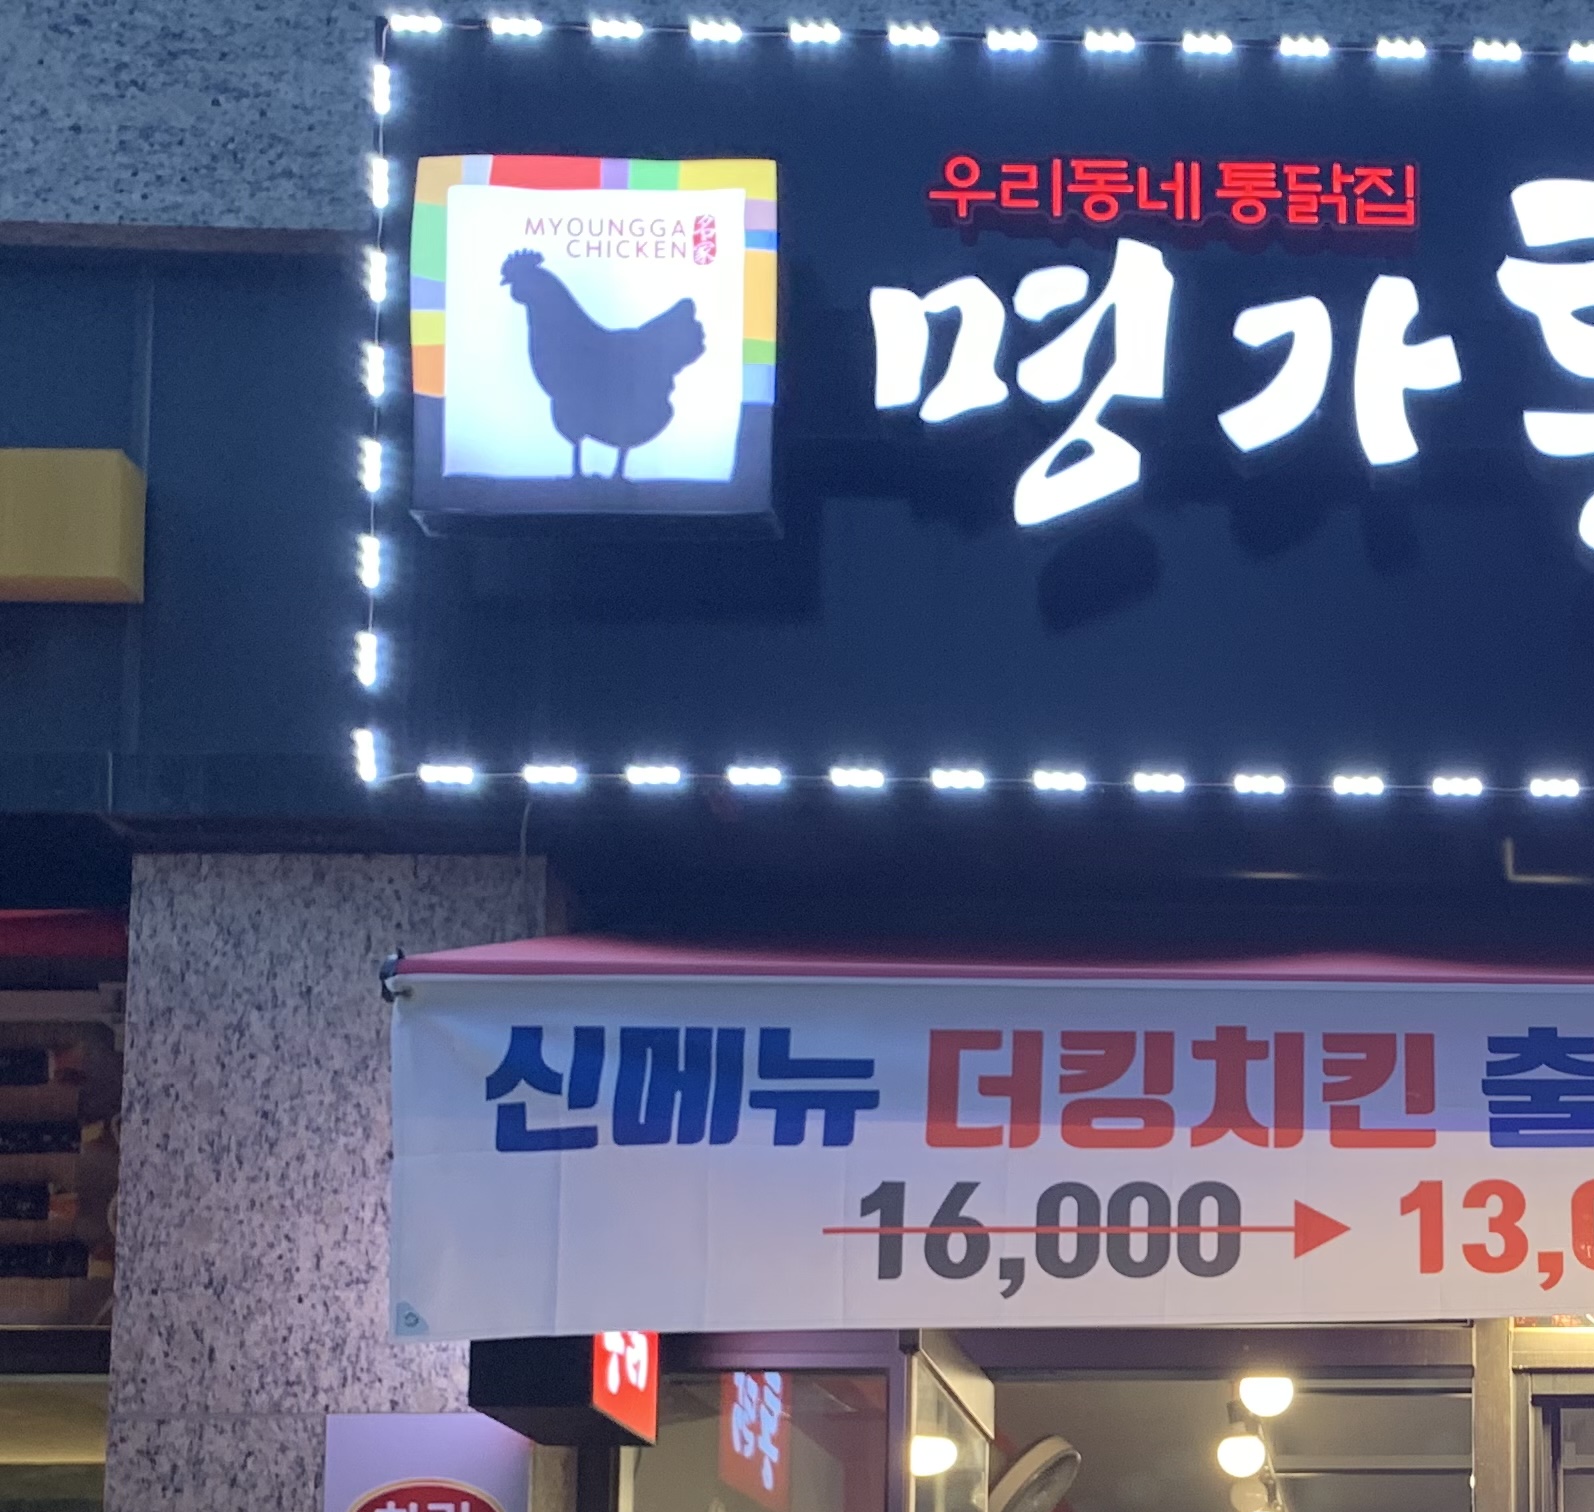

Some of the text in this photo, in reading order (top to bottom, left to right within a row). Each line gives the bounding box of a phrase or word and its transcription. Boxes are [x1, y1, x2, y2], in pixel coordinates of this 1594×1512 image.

[928, 155, 1418, 226] 우리동네 통닭집
[524, 216, 687, 238] MYOUNGGA
[566, 239, 688, 260] CHICKEN
[485, 1025, 880, 1153] 신메뉴
[925, 1025, 1437, 1149] 더킹치킨
[858, 1180, 1242, 1300] 16,000
